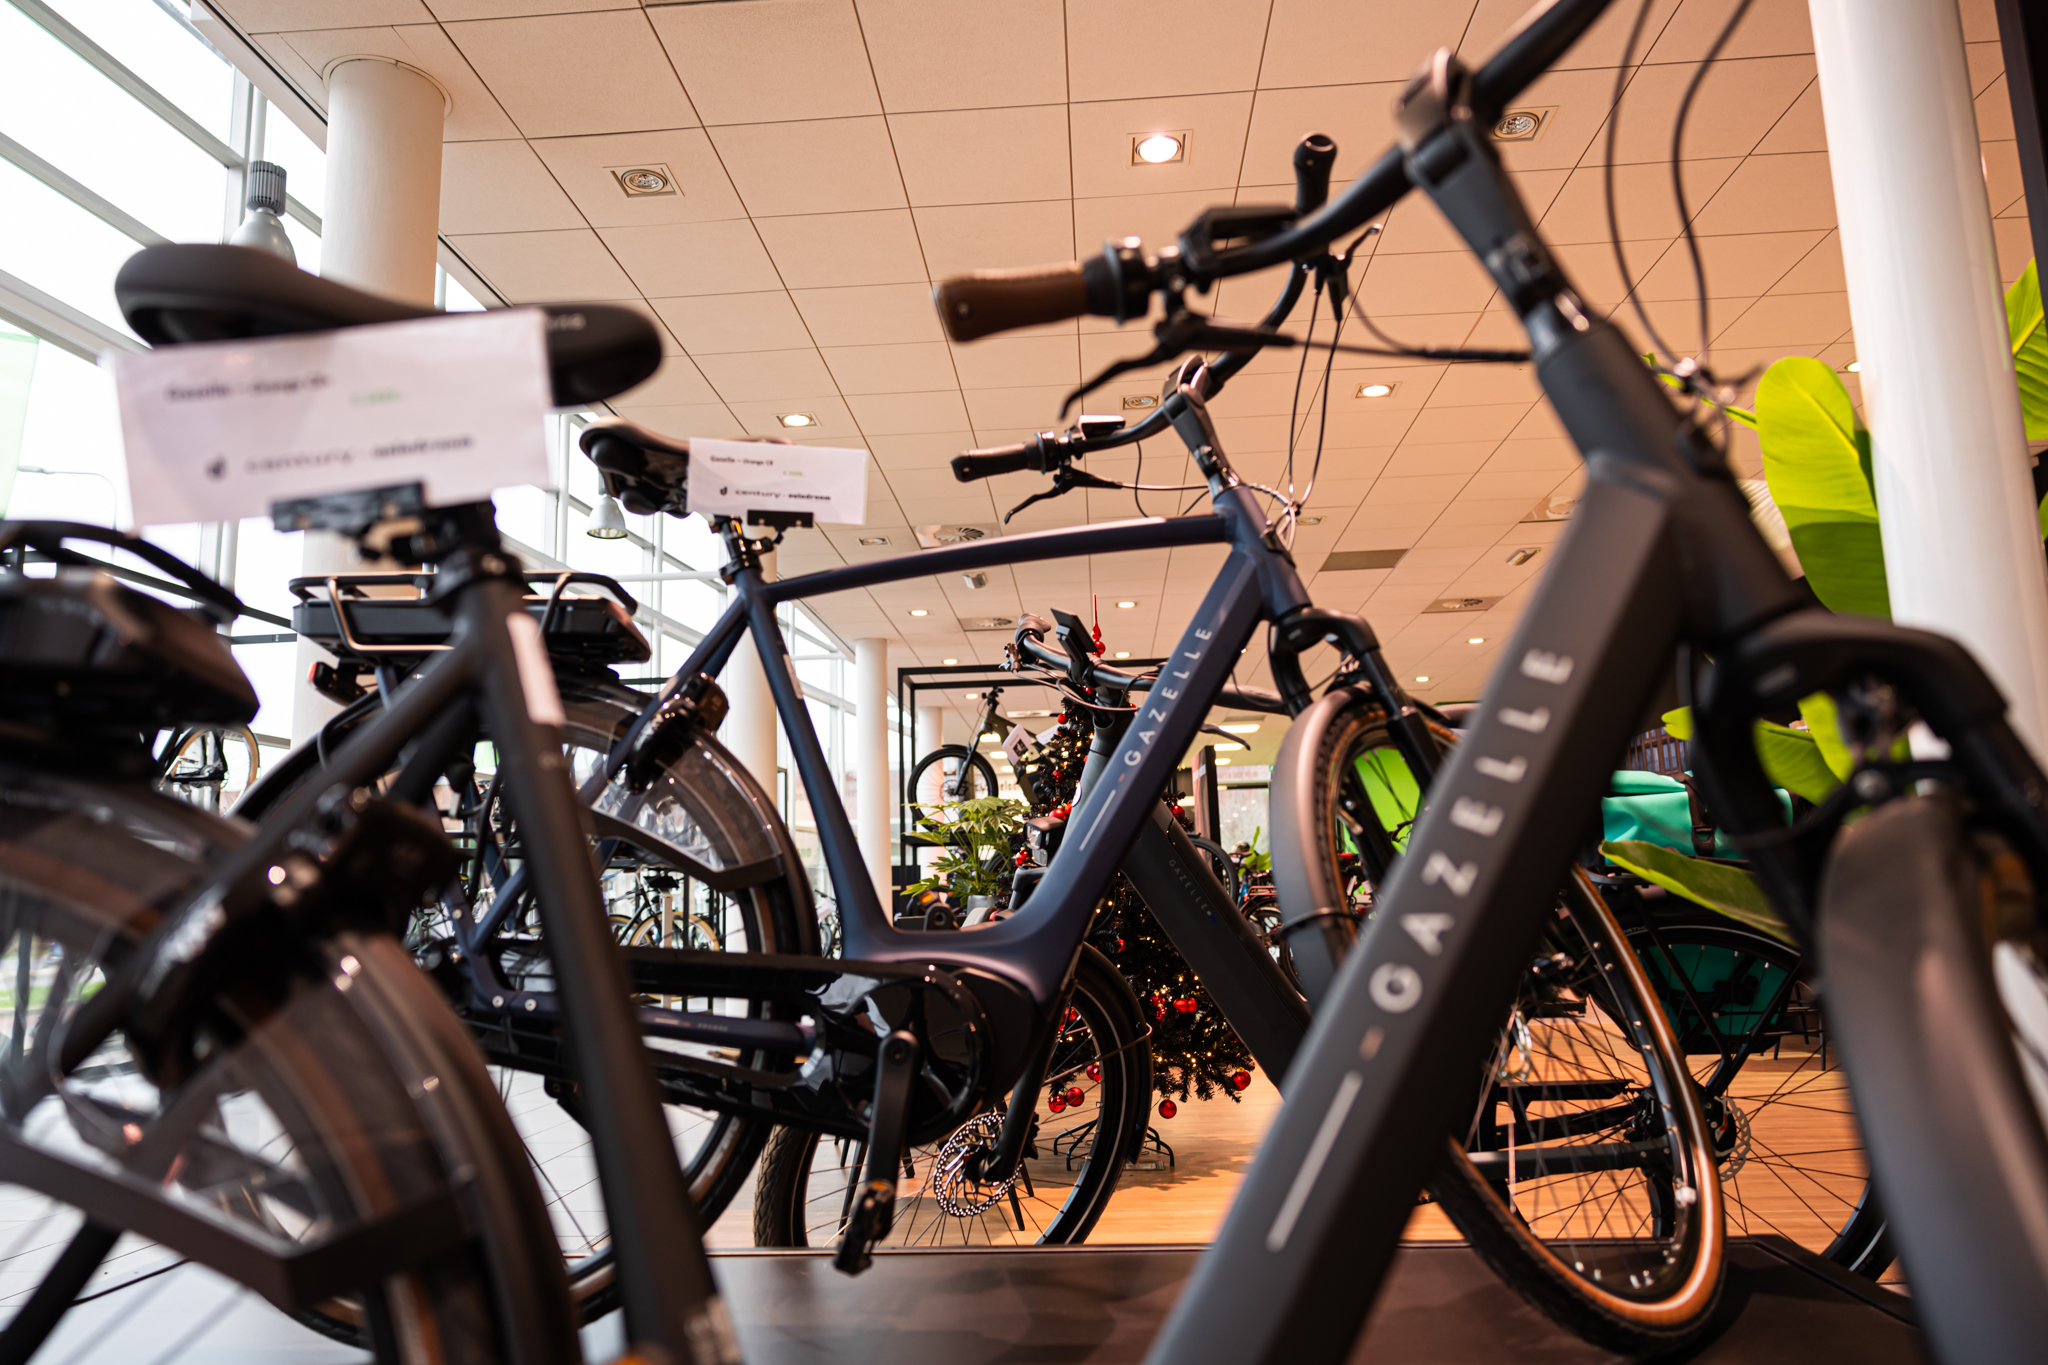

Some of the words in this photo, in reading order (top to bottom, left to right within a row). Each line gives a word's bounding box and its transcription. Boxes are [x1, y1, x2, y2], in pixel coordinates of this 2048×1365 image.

[1124, 628, 1212, 766] GAZELLE
[1168, 859, 1208, 910] GAZELLE
[1368, 648, 1575, 1013] GAZELLE
